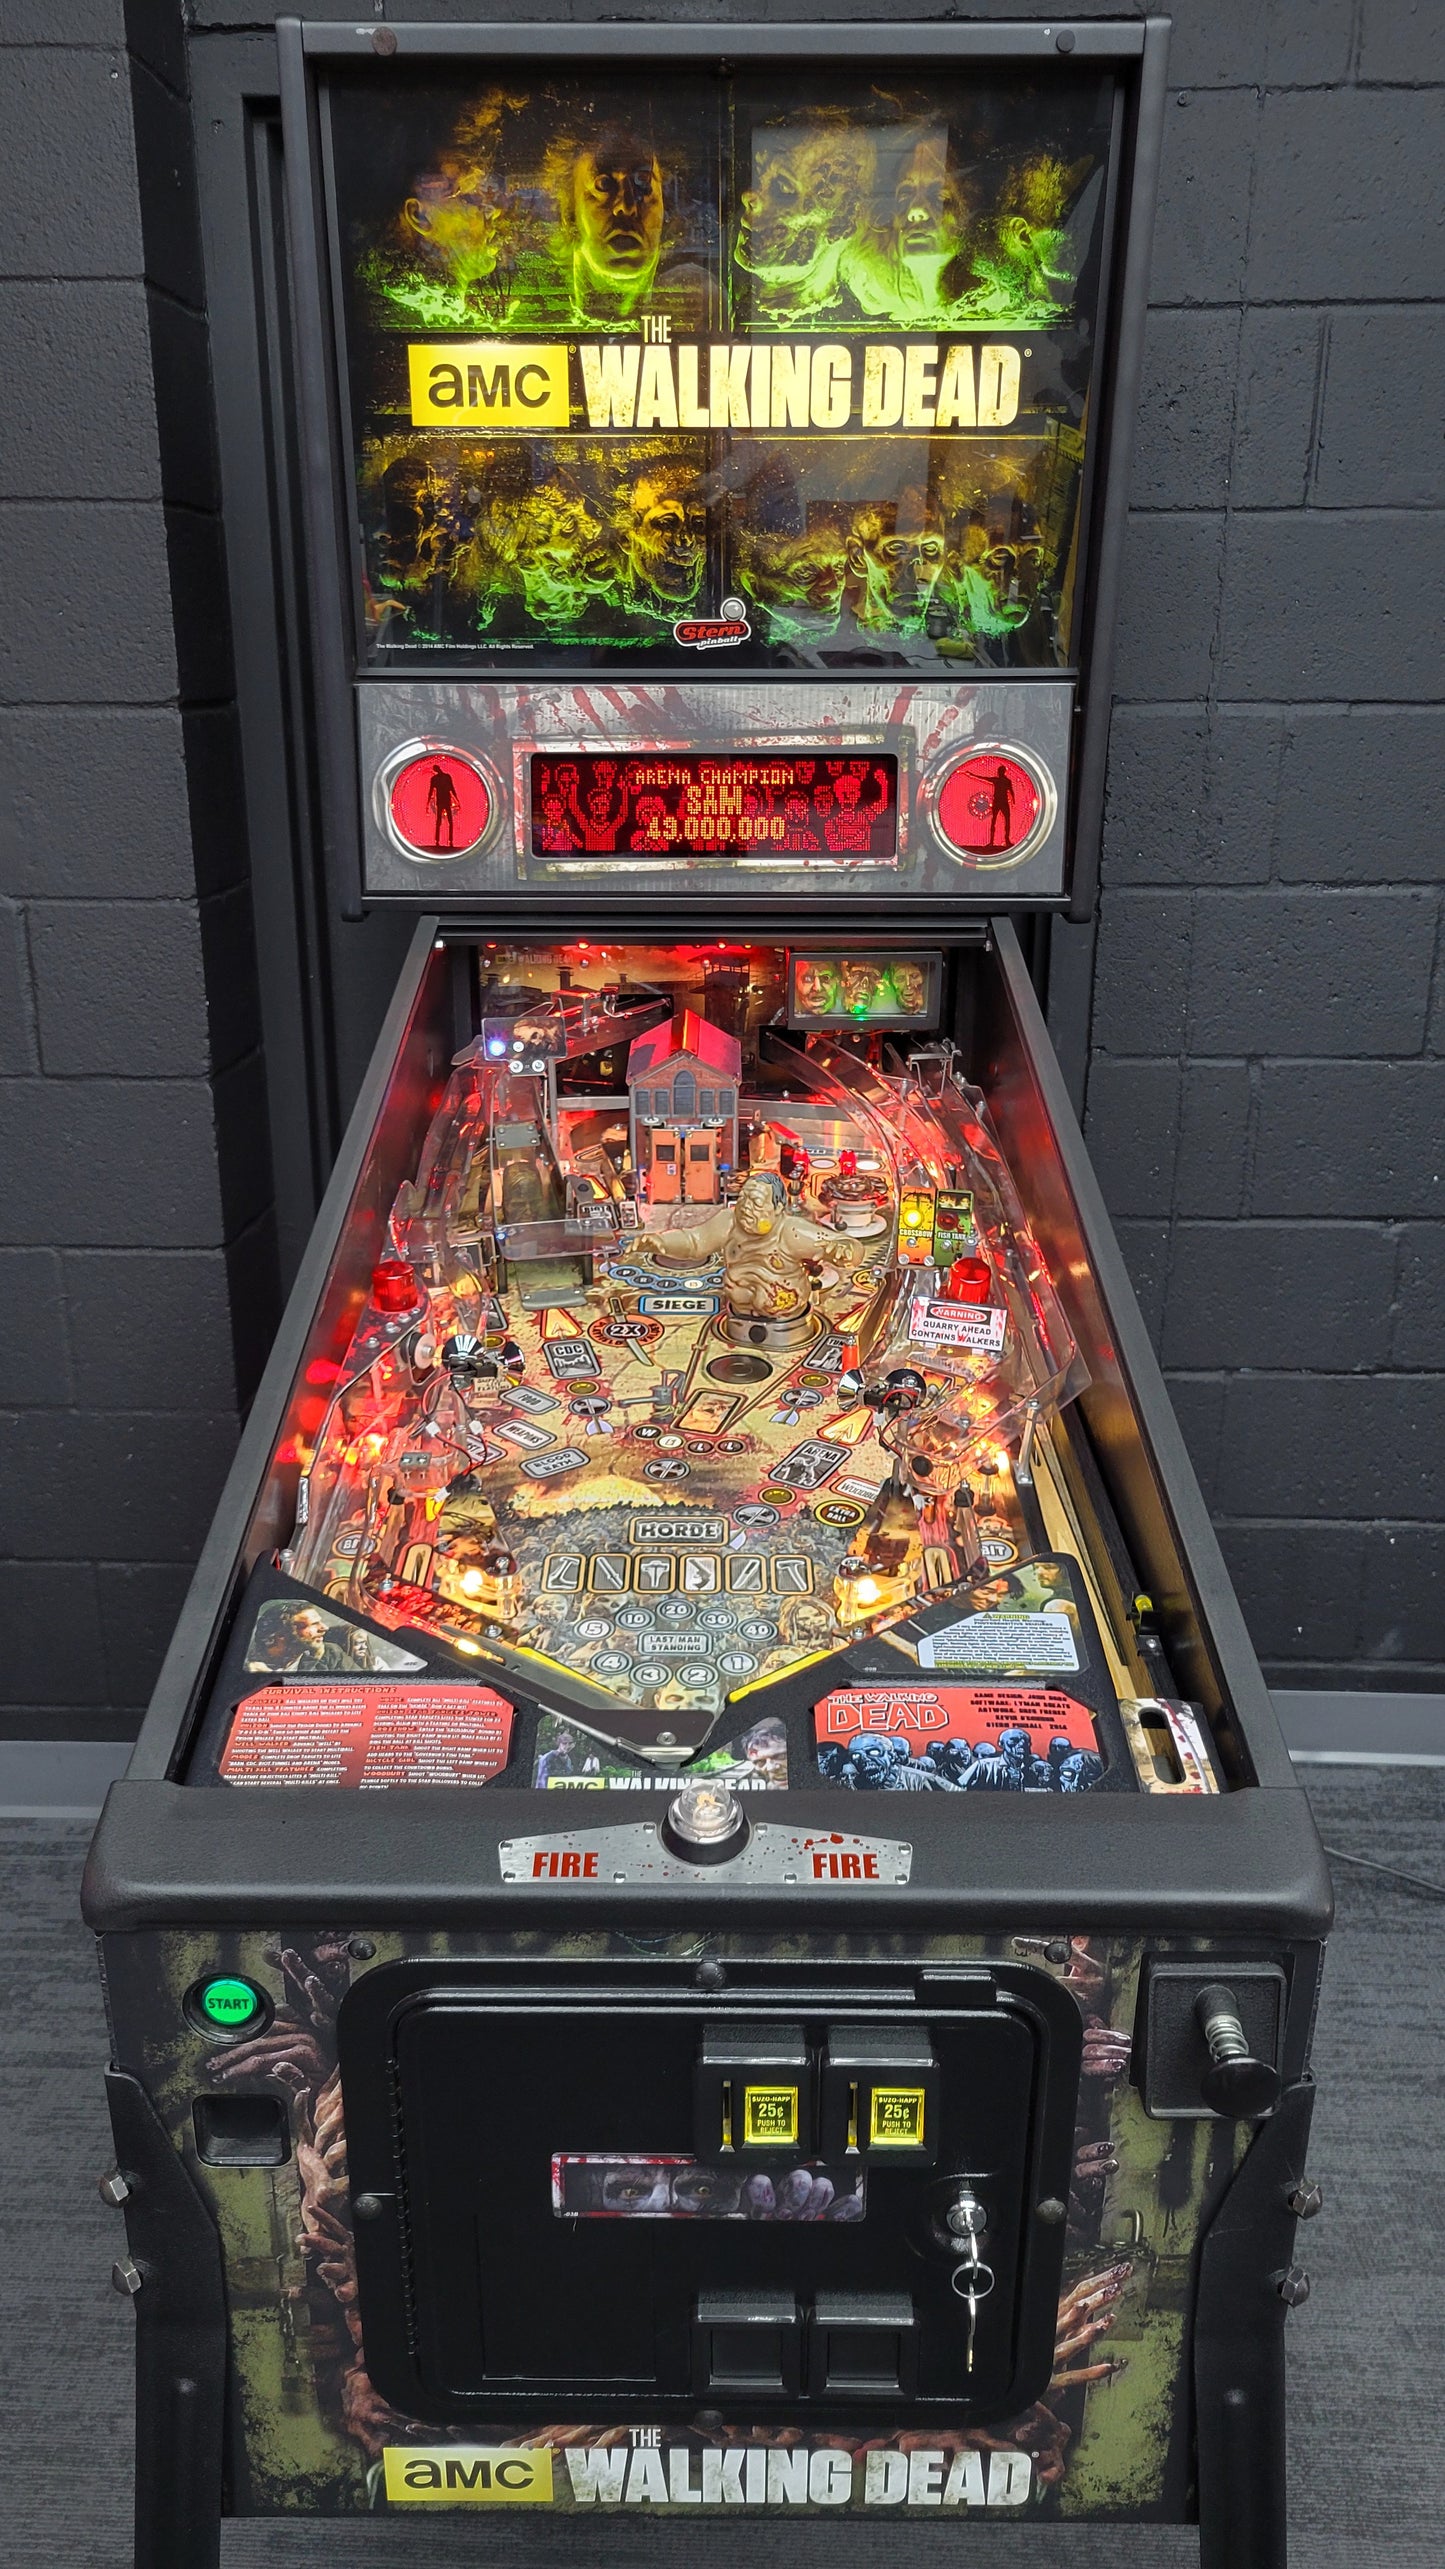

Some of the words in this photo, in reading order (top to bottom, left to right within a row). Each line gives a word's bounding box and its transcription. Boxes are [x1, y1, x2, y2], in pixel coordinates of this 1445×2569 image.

[642, 315, 672, 343] THE
[428, 363, 551, 409] amc
[580, 344, 854, 429] WALKING
[862, 345, 1022, 429] DEAD
[681, 621, 746, 641] Stern
[699, 635, 739, 648] pinball
[635, 769, 691, 785] ARENA
[700, 769, 794, 785] CHAMPION
[686, 785, 743, 815] SAM
[899, 1228, 933, 1238] CROSSBOW
[652, 1300, 706, 1310] SIEGE
[935, 1307, 983, 1321] WARNING
[610, 1325, 642, 1336] 2X
[922, 1320, 960, 1332] QUARRY
[960, 1324, 992, 1336] AHEAD
[912, 1330, 956, 1342] CONTAINS
[957, 1332, 1001, 1348] WALKERS
[555, 1345, 583, 1357] CDC
[518, 1393, 542, 1406] FOOD
[506, 1425, 543, 1444] WEAPONS
[640, 1428, 655, 1438] W
[534, 1452, 572, 1468] BLOOD
[803, 1446, 840, 1462] ARENA
[543, 1458, 574, 1472] BATH
[840, 1482, 876, 1500] WOODBU
[826, 1512, 847, 1524] BALL
[828, 1504, 856, 1518] EXTRA
[638, 1522, 722, 1539] HORDE
[664, 1605, 686, 1615] 20
[625, 1614, 645, 1624] 10
[706, 1614, 728, 1624] 30
[584, 1624, 602, 1634] 5
[745, 1624, 768, 1636] 40
[602, 1656, 622, 1668] 4
[731, 1657, 744, 1668] 1
[642, 1669, 660, 1681] 3
[688, 1669, 708, 1681] 2
[827, 1693, 864, 1704] THE
[864, 1692, 938, 1703] WALKING
[828, 1702, 949, 1733] DEAD
[532, 1852, 599, 1878] FIRE
[812, 1853, 880, 1880] FIRE
[208, 1998, 250, 2010] START
[758, 2103, 784, 2118] 25¢
[884, 2104, 910, 2120] 25¢
[628, 2428, 662, 2448] THE
[404, 2458, 535, 2490] amc
[564, 2448, 853, 2504] WALKING
[864, 2450, 1032, 2506] DEAD
